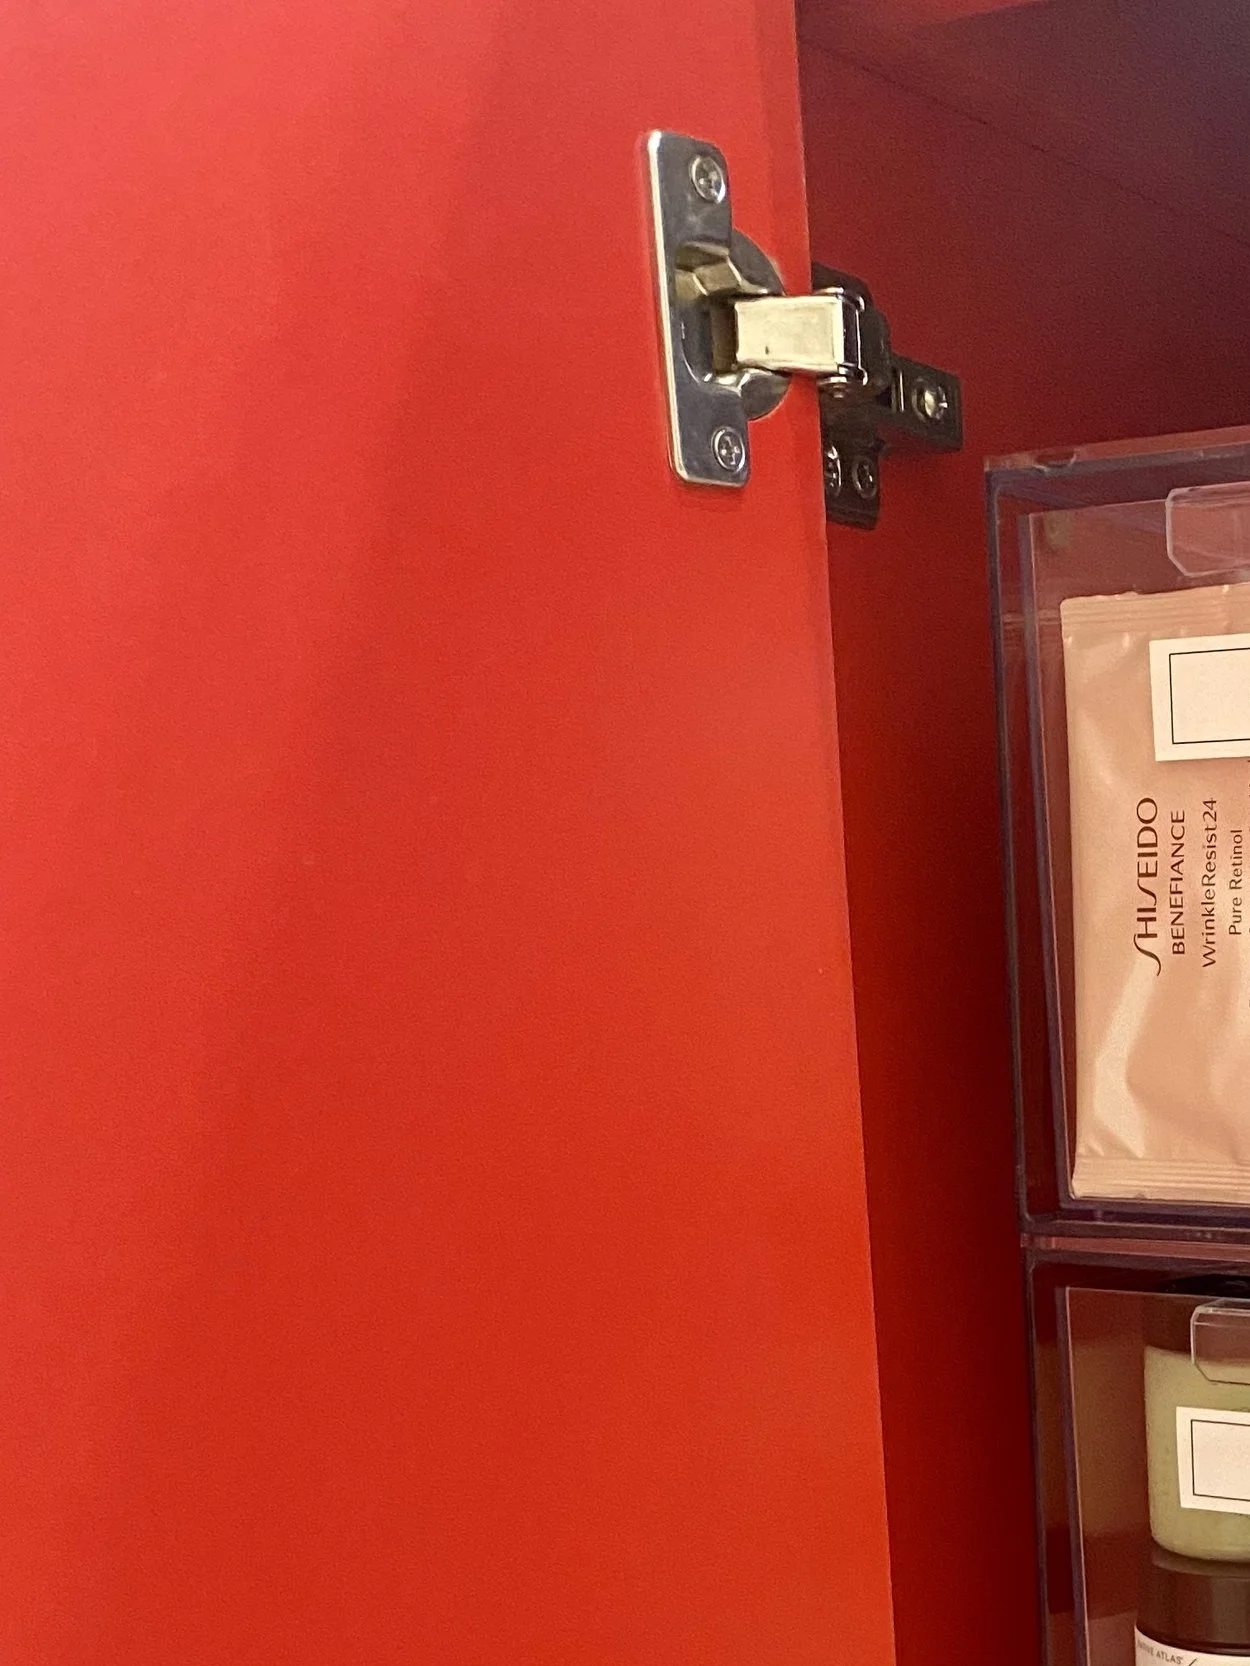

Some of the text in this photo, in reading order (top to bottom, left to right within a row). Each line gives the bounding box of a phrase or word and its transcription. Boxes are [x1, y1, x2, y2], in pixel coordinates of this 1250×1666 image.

[1133, 797, 1162, 977] SHISEIDO
[1169, 809, 1186, 955] BENEFIANCE
[1201, 797, 1217, 968] WrinkleResist24
[1228, 829, 1243, 936] Pure Retinol
